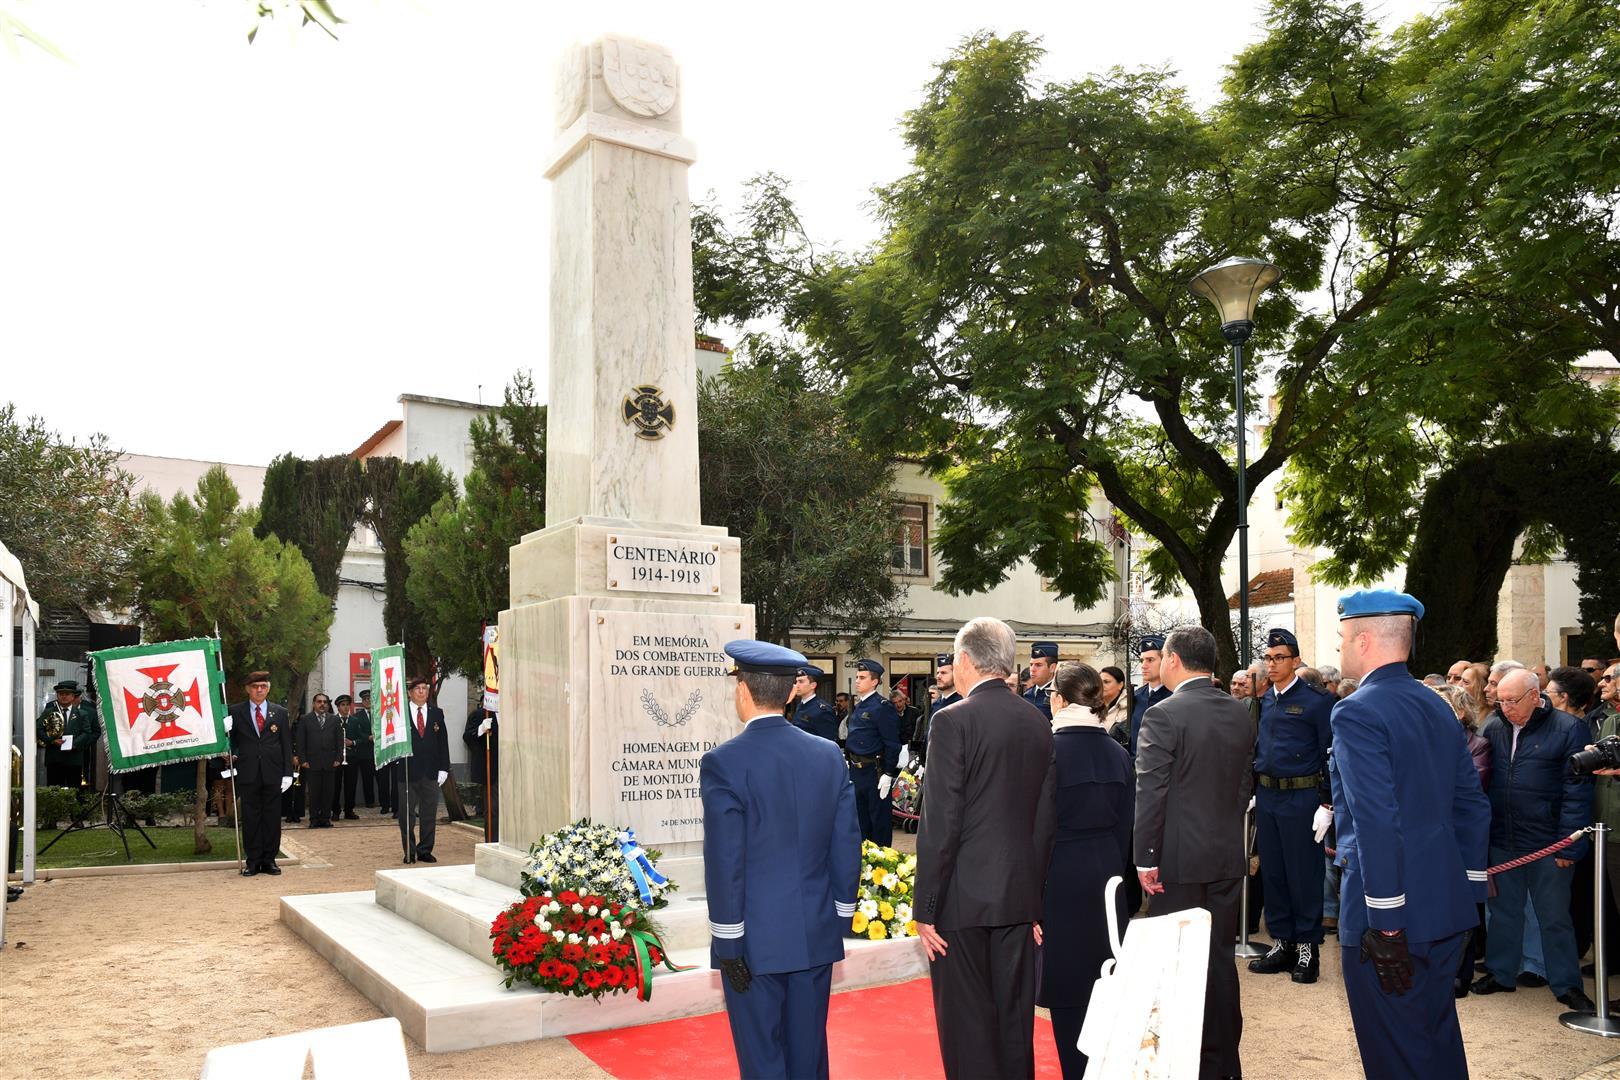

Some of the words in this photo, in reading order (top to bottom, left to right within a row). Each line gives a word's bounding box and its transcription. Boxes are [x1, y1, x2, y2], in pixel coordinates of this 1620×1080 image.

[613, 545, 716, 566] CENTENÁRIO
[632, 566, 701, 583] 1914-1918
[633, 635, 650, 647] EM
[654, 634, 709, 648] MEMÓRIA
[615, 650, 640, 661] DOS
[643, 650, 726, 663] COMBATENTES
[611, 664, 628, 676] DA
[631, 664, 681, 676] GRANDE
[683, 665, 729, 677] GUERRA
[623, 741, 700, 754] HOMENAGEM
[612, 758, 664, 771] CÂMARA
[623, 775, 639, 787] DE
[643, 773, 694, 785] MONTIJO
[621, 789, 663, 802] FILHOS
[666, 788, 682, 800] DA
[661, 819, 668, 827] 24
[669, 819, 679, 827] DE
